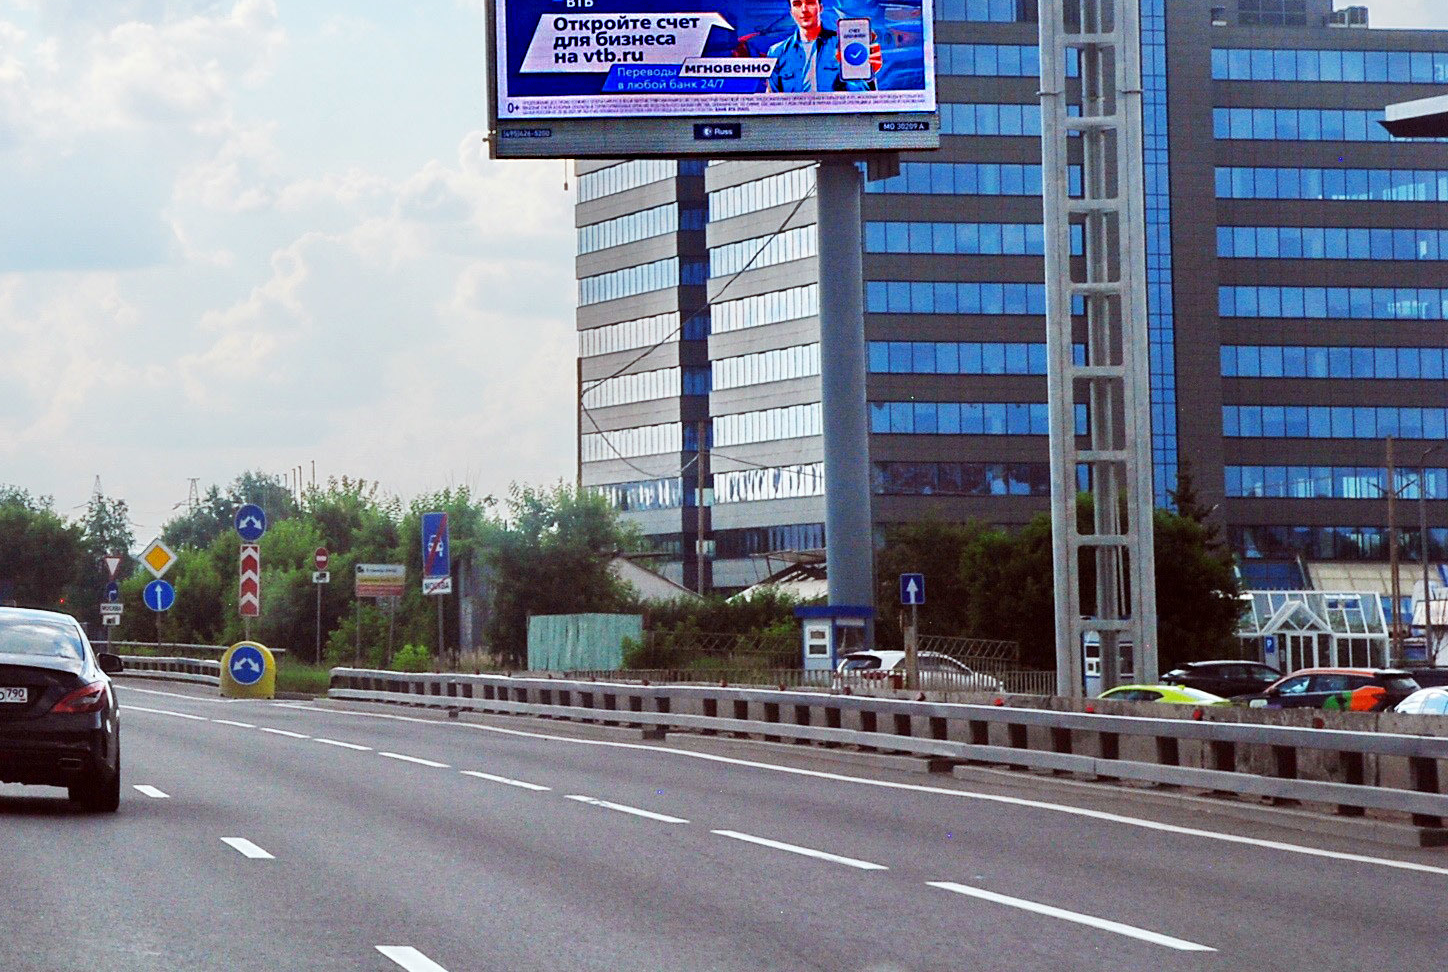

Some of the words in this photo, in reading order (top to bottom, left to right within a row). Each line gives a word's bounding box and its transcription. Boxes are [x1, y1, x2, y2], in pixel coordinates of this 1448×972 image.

[553, 15, 652, 34] Откройте
[656, 17, 700, 29] счет
[553, 36, 590, 50] для
[595, 32, 676, 46] бизнеса
[554, 52, 578, 64] на
[583, 48, 644, 63] vtb.ru
[617, 67, 677, 81] Переводы
[684, 62, 771, 74] мгновенно
[628, 79, 667, 90] любой
[669, 79, 698, 90] банк
[701, 79, 725, 89] 24/7
[507, 102, 520, 113] 0+
[714, 127, 733, 135] Russ
